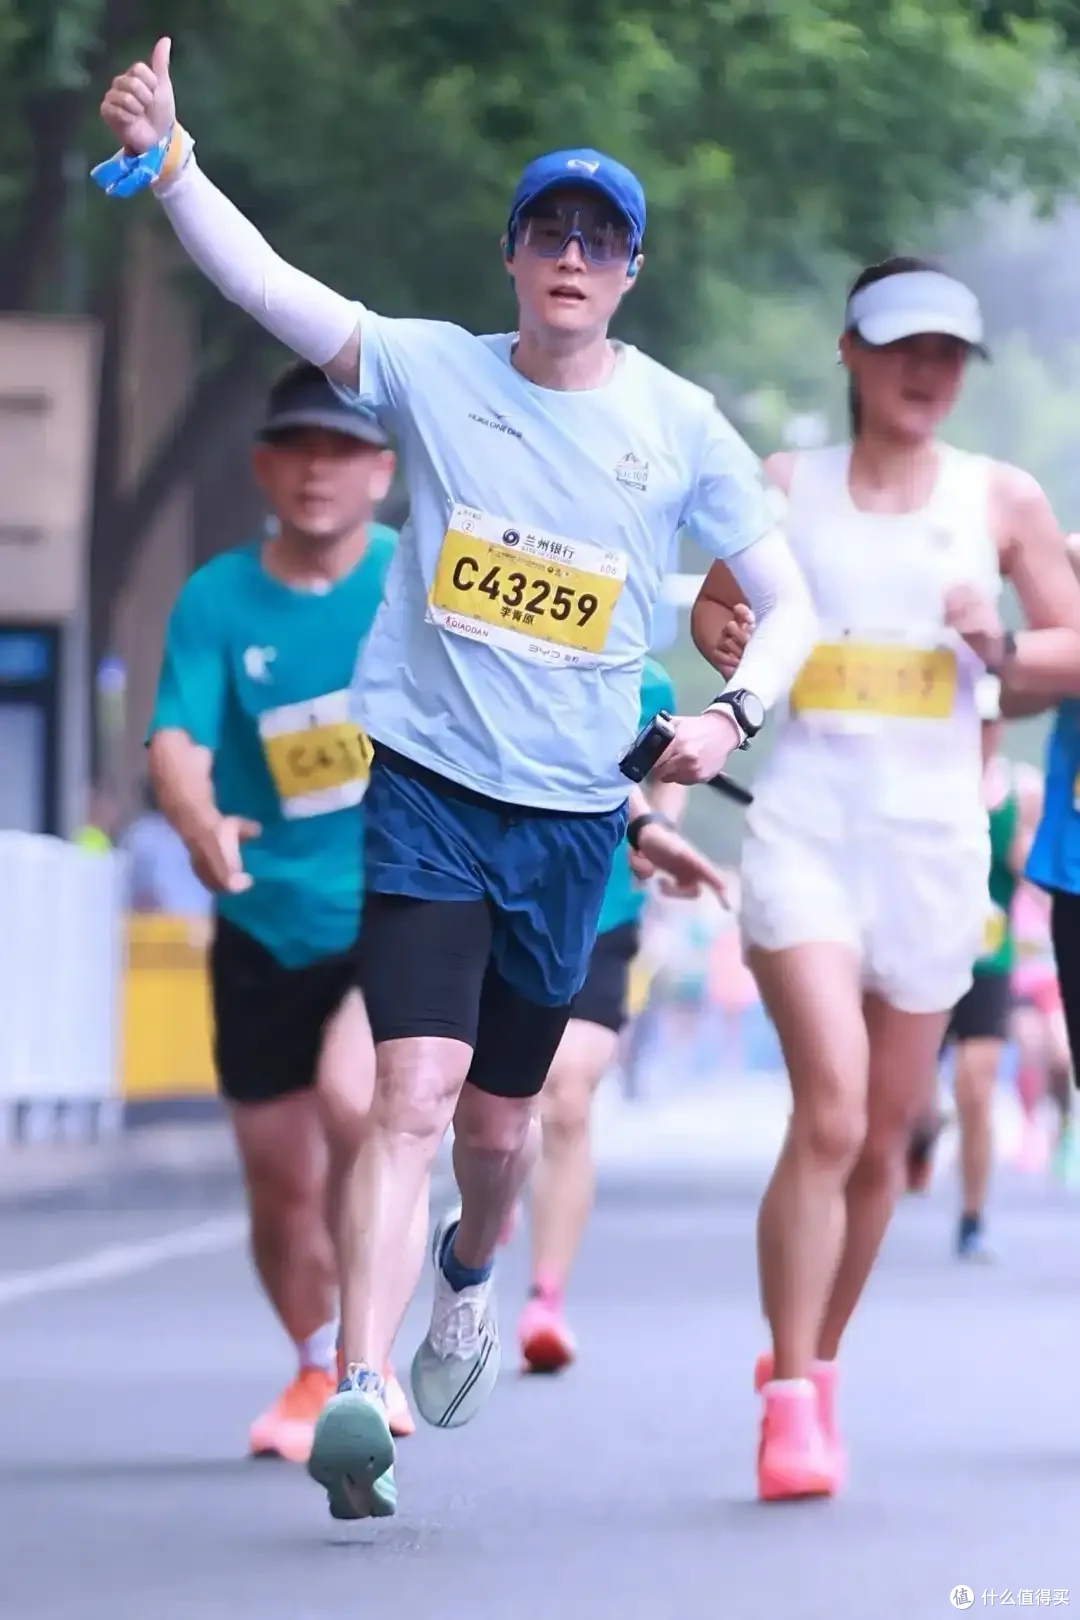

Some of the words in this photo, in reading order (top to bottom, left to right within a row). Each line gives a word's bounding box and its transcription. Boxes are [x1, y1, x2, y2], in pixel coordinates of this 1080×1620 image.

[523, 533, 575, 560] 兰州银行
[452, 556, 599, 627] C43259
[499, 605, 536, 626] 李青原
[451, 620, 489, 637] QIAODAN
